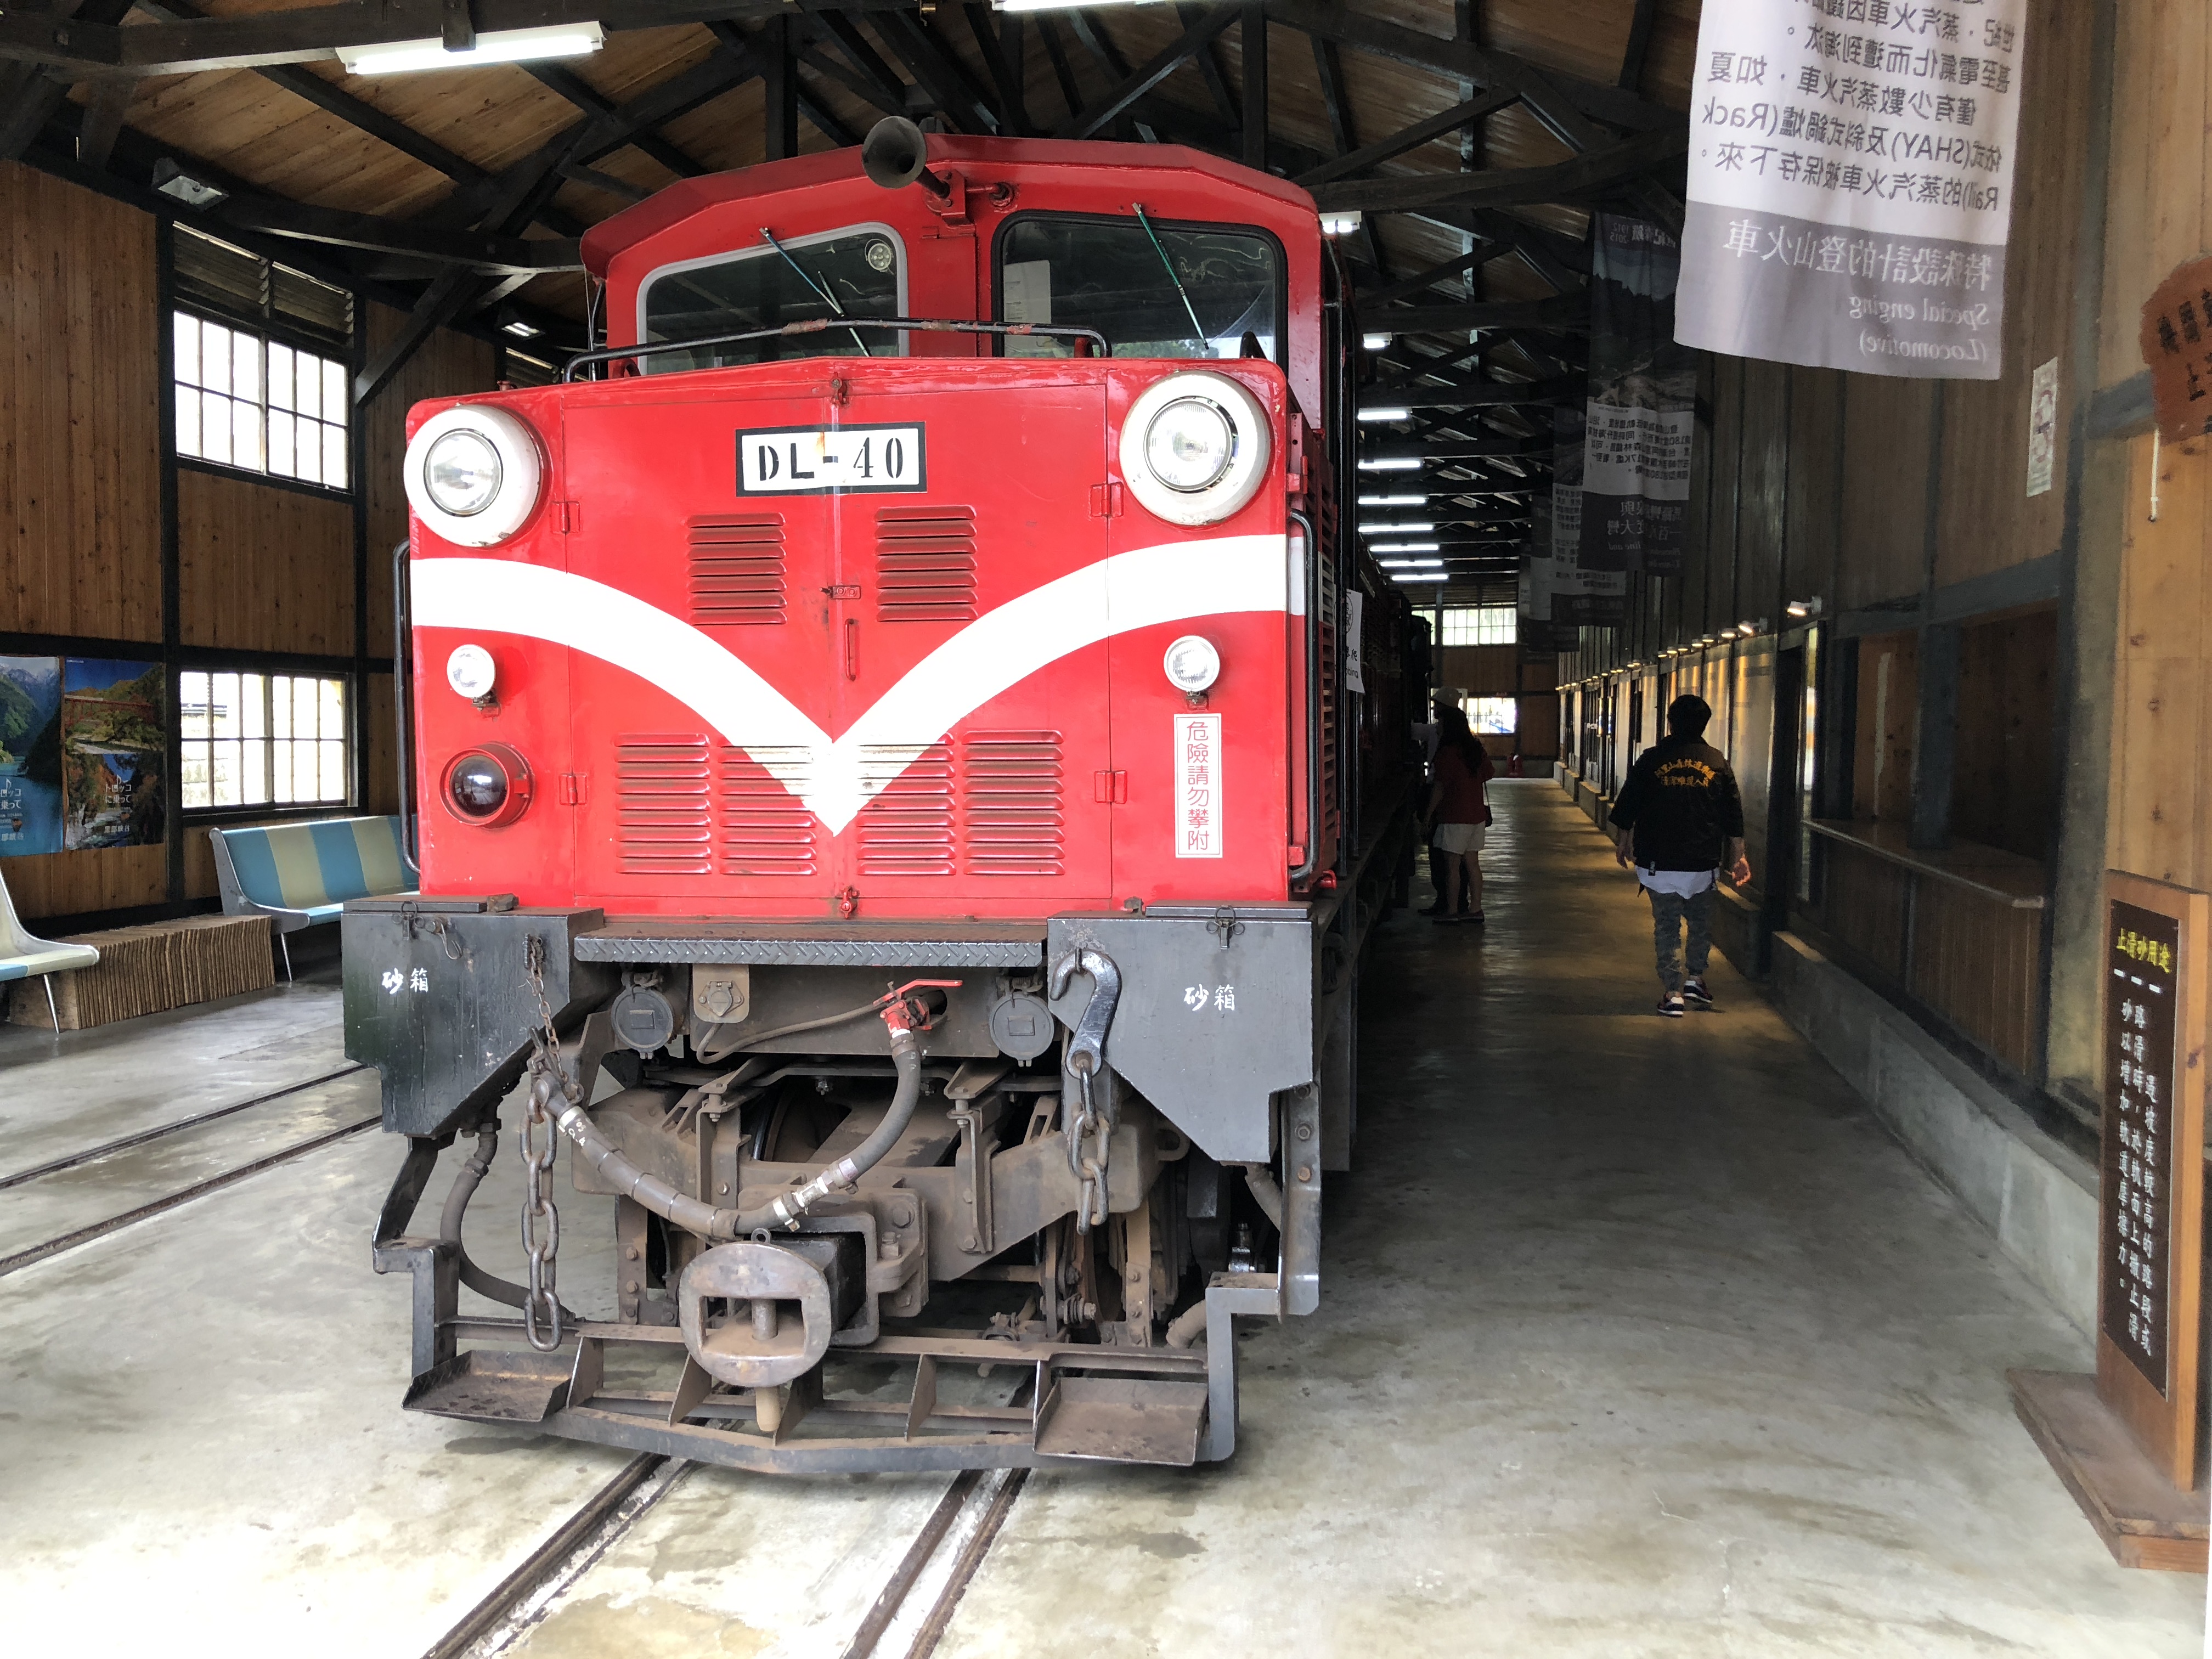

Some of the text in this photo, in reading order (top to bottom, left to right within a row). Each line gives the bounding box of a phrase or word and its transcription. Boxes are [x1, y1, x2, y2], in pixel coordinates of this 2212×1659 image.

[759, 437, 903, 481] DL-40
[1187, 721, 1209, 850] 危險請勿攀附
[2116, 928, 2171, 974] 止滑砂用途
[382, 967, 429, 994] 砂箱
[1184, 984, 1235, 1012] 砂箱
